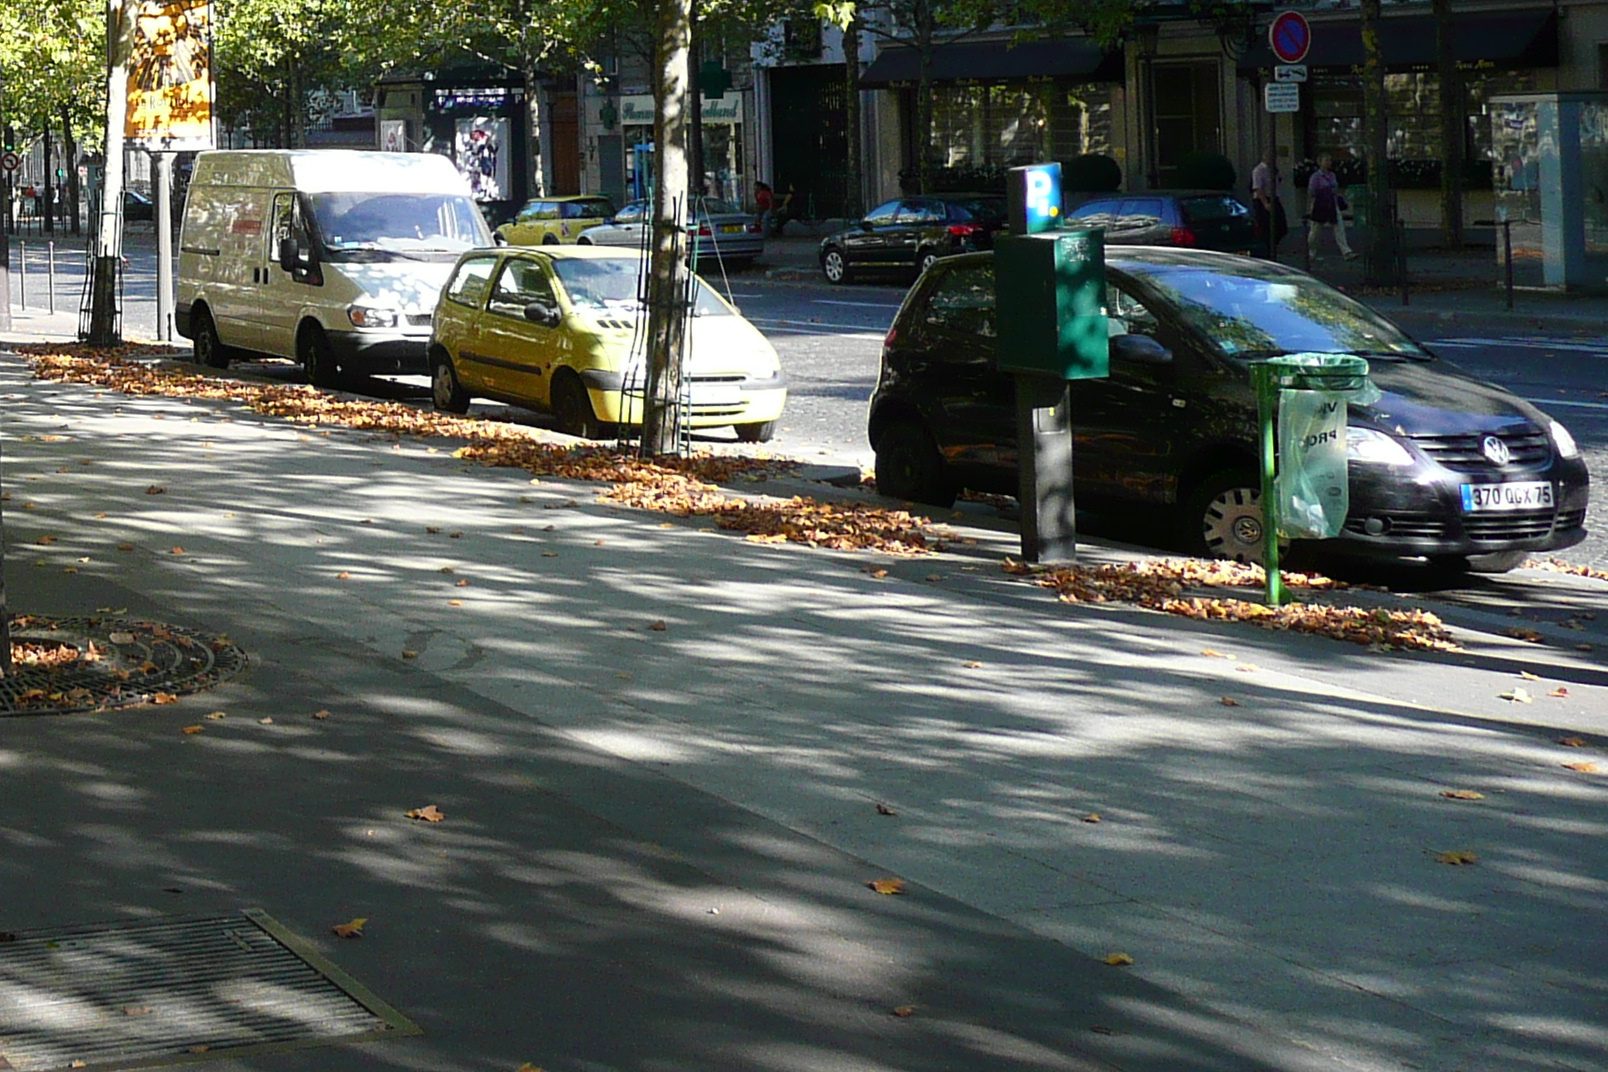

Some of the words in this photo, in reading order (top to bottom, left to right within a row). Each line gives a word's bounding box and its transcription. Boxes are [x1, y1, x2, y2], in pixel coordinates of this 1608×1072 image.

[1027, 170, 1052, 208] P
[1473, 488, 1501, 506] 370
[1535, 485, 1552, 504] 75
